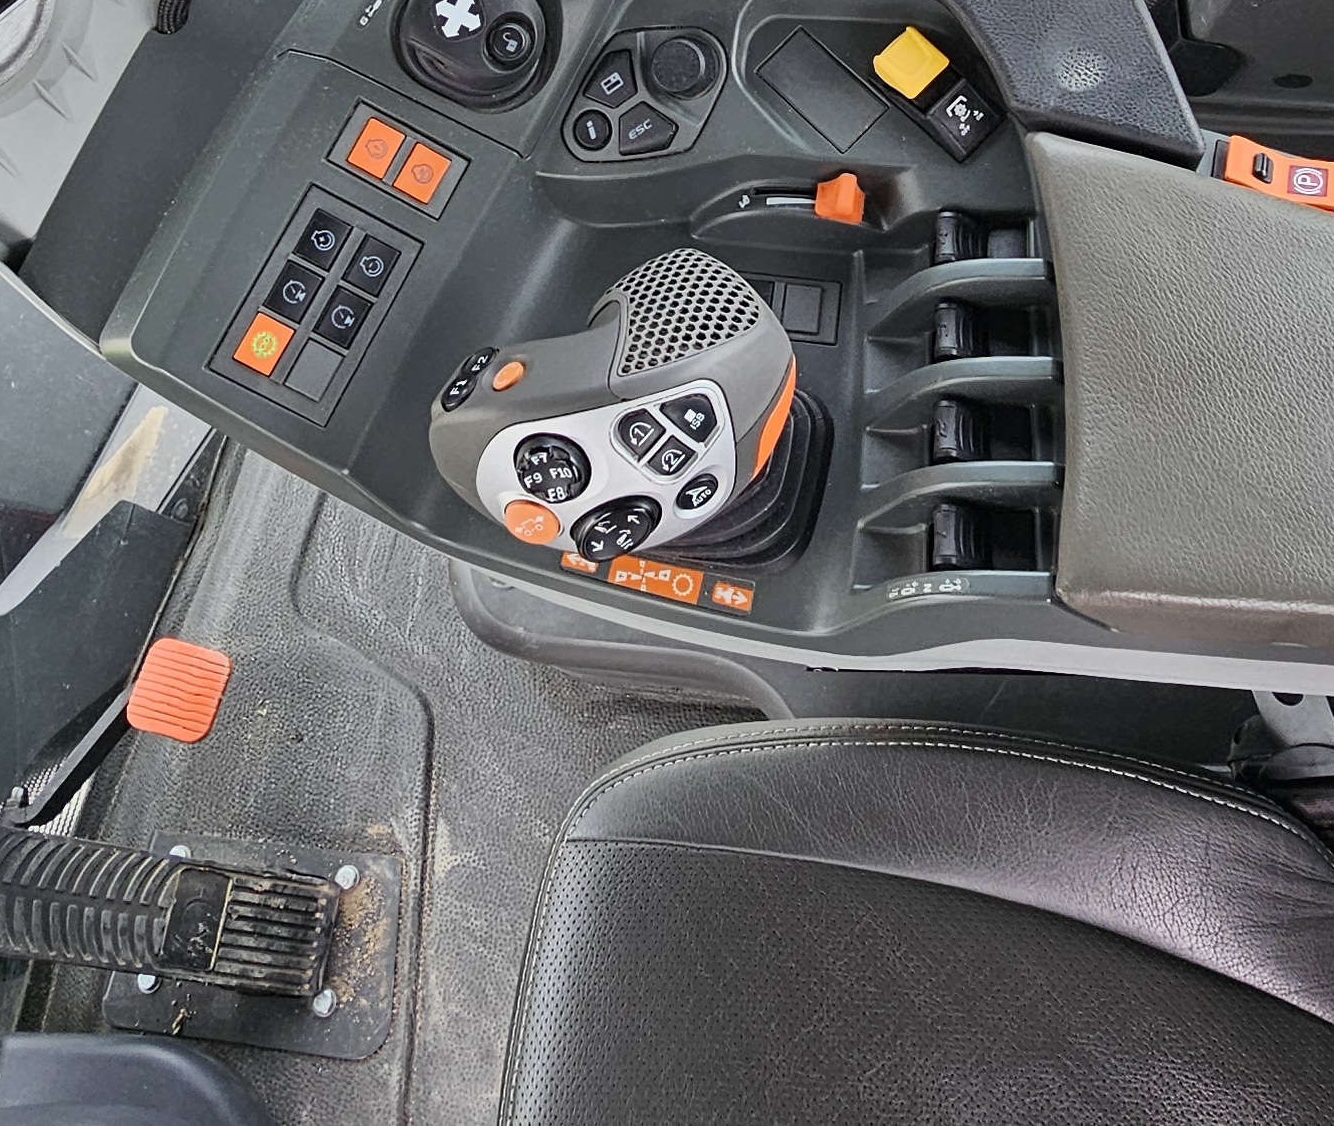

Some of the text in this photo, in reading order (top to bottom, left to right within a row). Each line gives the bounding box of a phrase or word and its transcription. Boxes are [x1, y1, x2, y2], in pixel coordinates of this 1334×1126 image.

[628, 118, 653, 140] ESC
[471, 354, 489, 372] F2
[449, 379, 468, 396] F1
[530, 452, 548, 466] F7
[665, 453, 679, 465] 2
[523, 467, 573, 489] F9 F10
[547, 485, 567, 503] F8
[693, 489, 712, 507] AUTO
